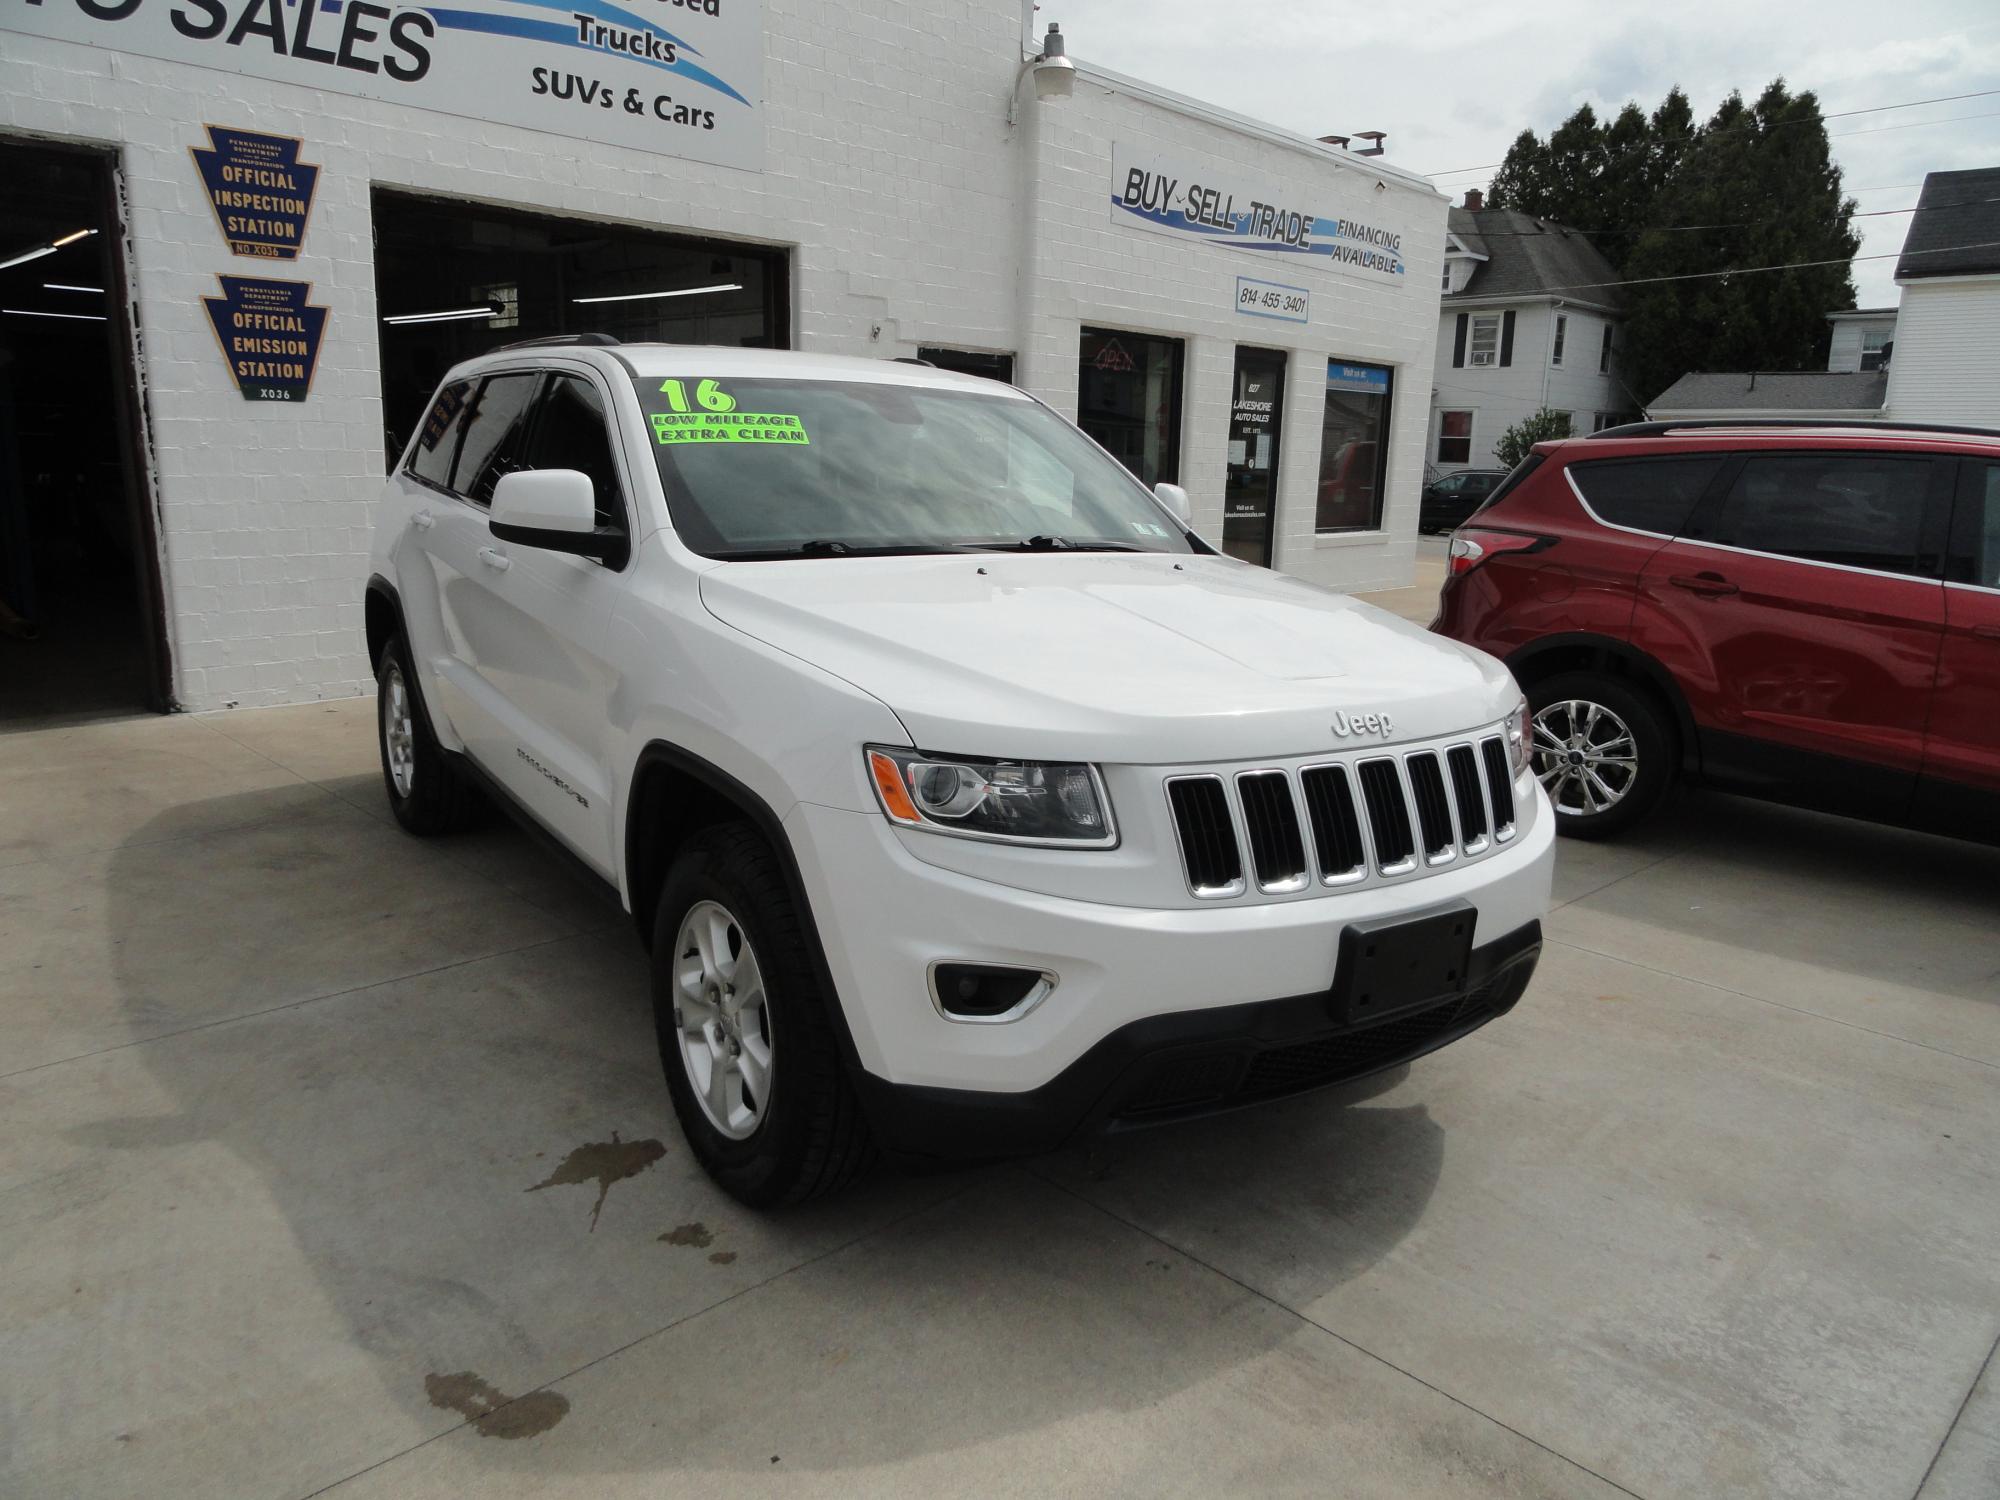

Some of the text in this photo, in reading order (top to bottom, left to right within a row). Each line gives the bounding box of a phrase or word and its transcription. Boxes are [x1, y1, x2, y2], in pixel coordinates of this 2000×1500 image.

[170, 0, 435, 82] SALES
[574, 13, 676, 63] Trucks
[531, 67, 715, 130] SUVs & Cars
[222, 165, 297, 190] OFFICIAL
[215, 190, 305, 216] INSPECTION
[1123, 168, 1314, 249] BUY SELL TRADE
[228, 216, 296, 238] STATION
[1337, 219, 1401, 250] FINANCING
[1332, 245, 1398, 274] AVAILABLE
[233, 312, 306, 332] OFFICIAL
[233, 336, 308, 356] EMISSION
[238, 361, 304, 379] STATION
[260, 388, 290, 400] X036
[659, 379, 736, 412] 16
[1233, 400, 1272, 411] LAKESHORE
[653, 415, 797, 427] LOW MILEAGE
[1234, 412, 1270, 423] AUTO SALES
[660, 429, 804, 442] EXTRA CLEAN
[1331, 710, 1393, 739] Jeep
